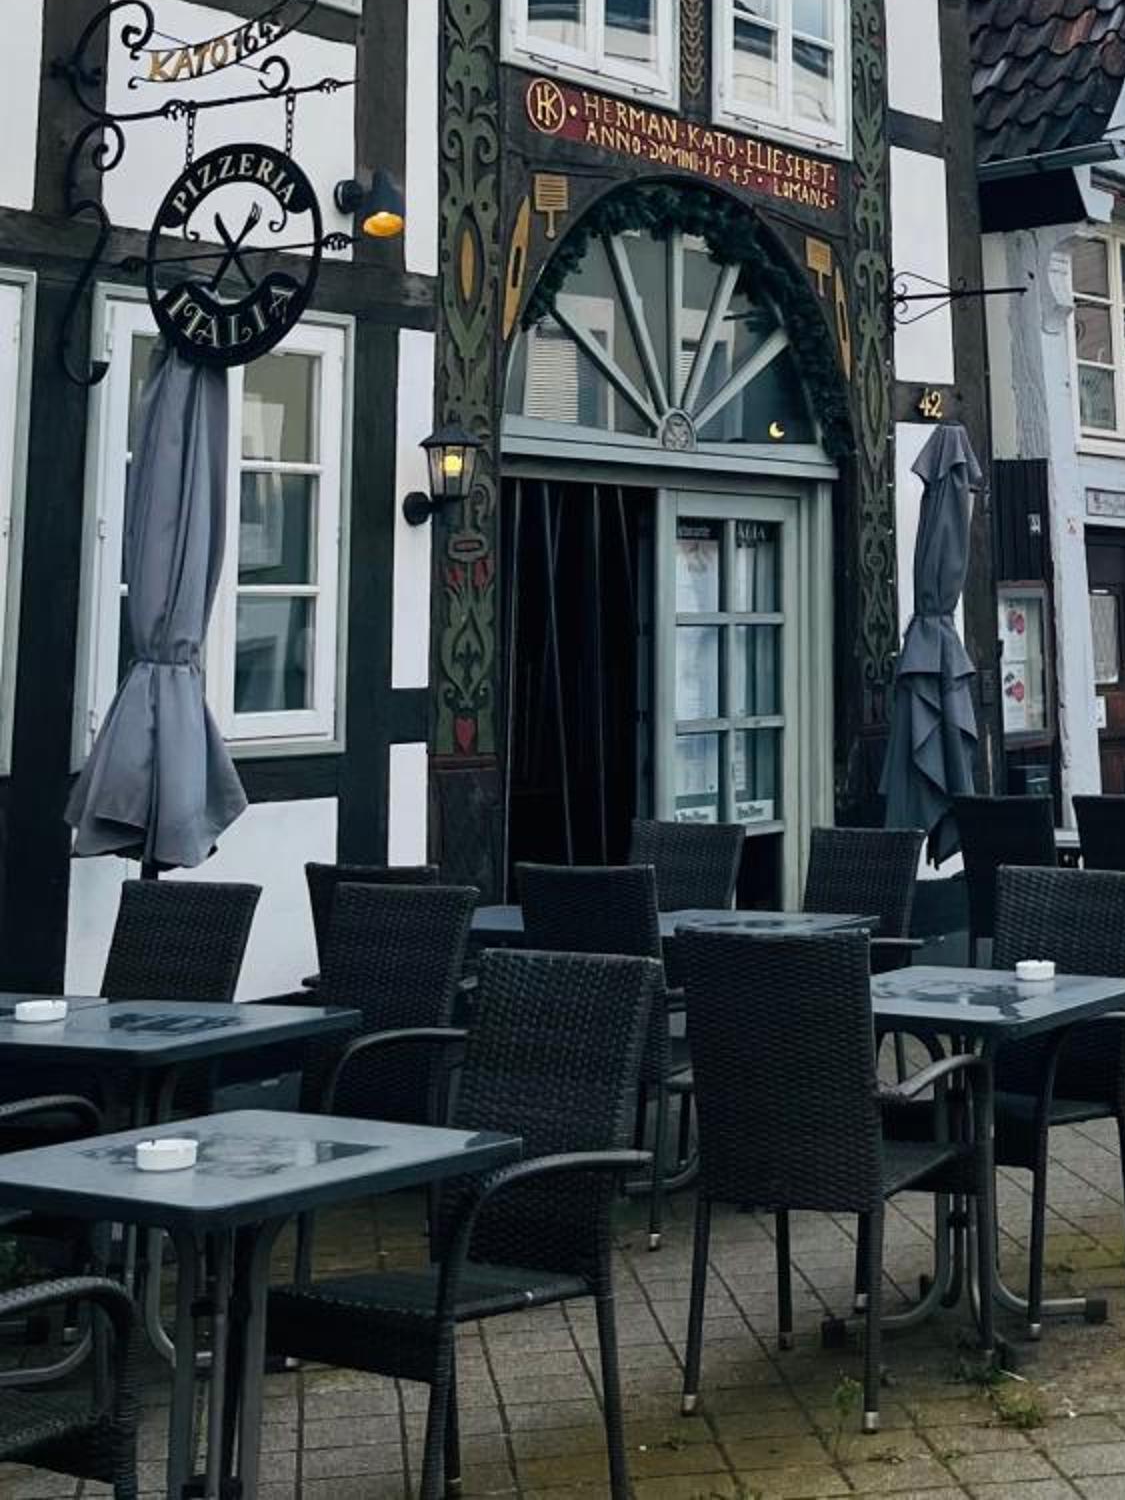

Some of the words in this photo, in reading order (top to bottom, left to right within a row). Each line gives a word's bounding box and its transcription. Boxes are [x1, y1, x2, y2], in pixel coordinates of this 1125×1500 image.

[148, 36, 229, 83] KATO
[583, 89, 678, 144] HERMAN
[687, 120, 737, 158] KATO
[585, 119, 641, 157] ANNO
[704, 151, 751, 186] 1645
[171, 151, 296, 215] PIZZERIA
[165, 283, 294, 348] ITALIA
[917, 387, 943, 419] 42
